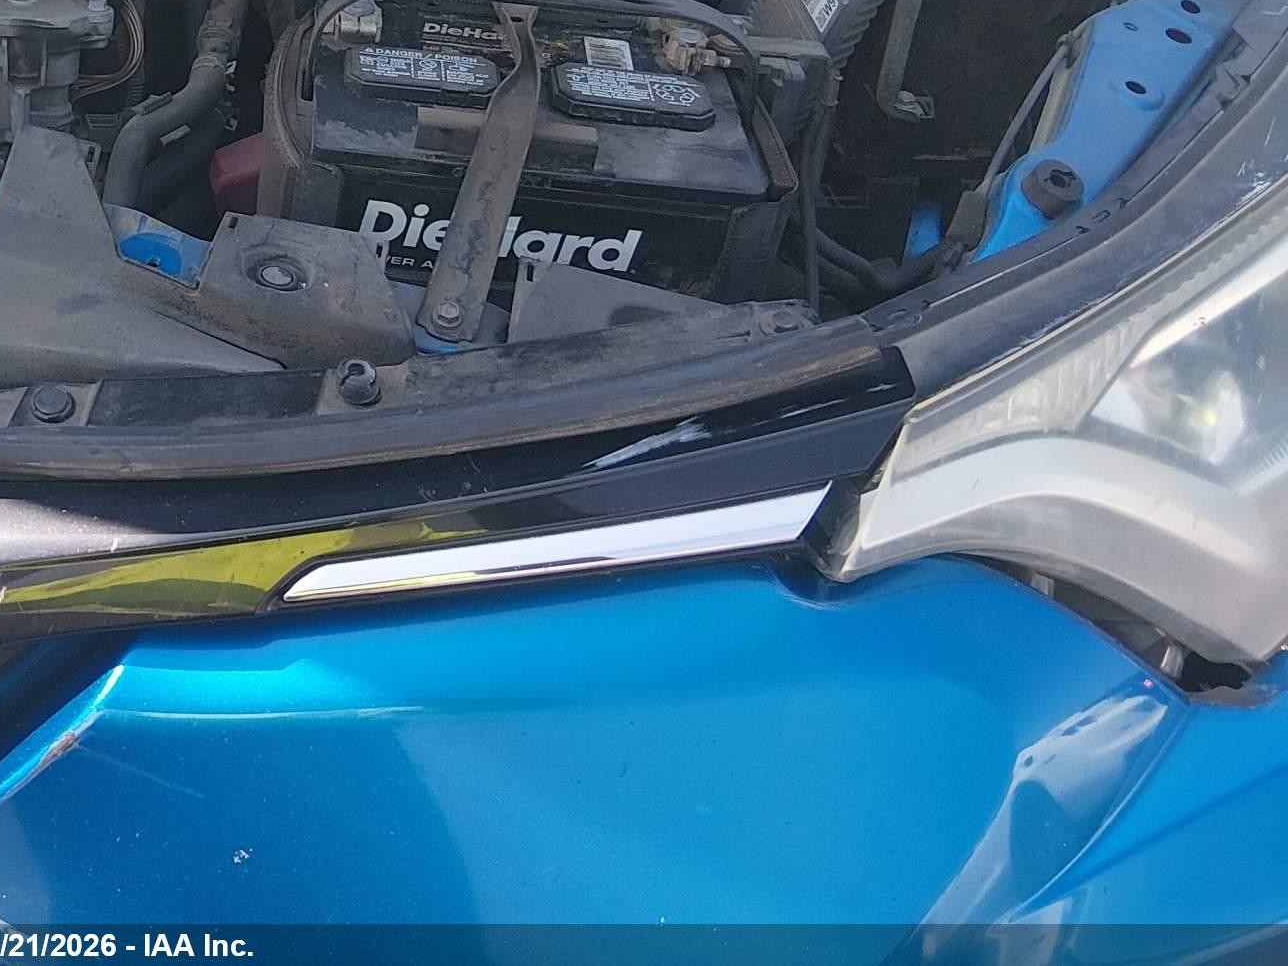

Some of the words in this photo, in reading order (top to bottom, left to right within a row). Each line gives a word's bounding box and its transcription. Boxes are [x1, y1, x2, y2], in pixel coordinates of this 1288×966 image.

[422, 21, 508, 41] DieHar
[375, 48, 423, 58] DANGER
[434, 53, 478, 64] POISON
